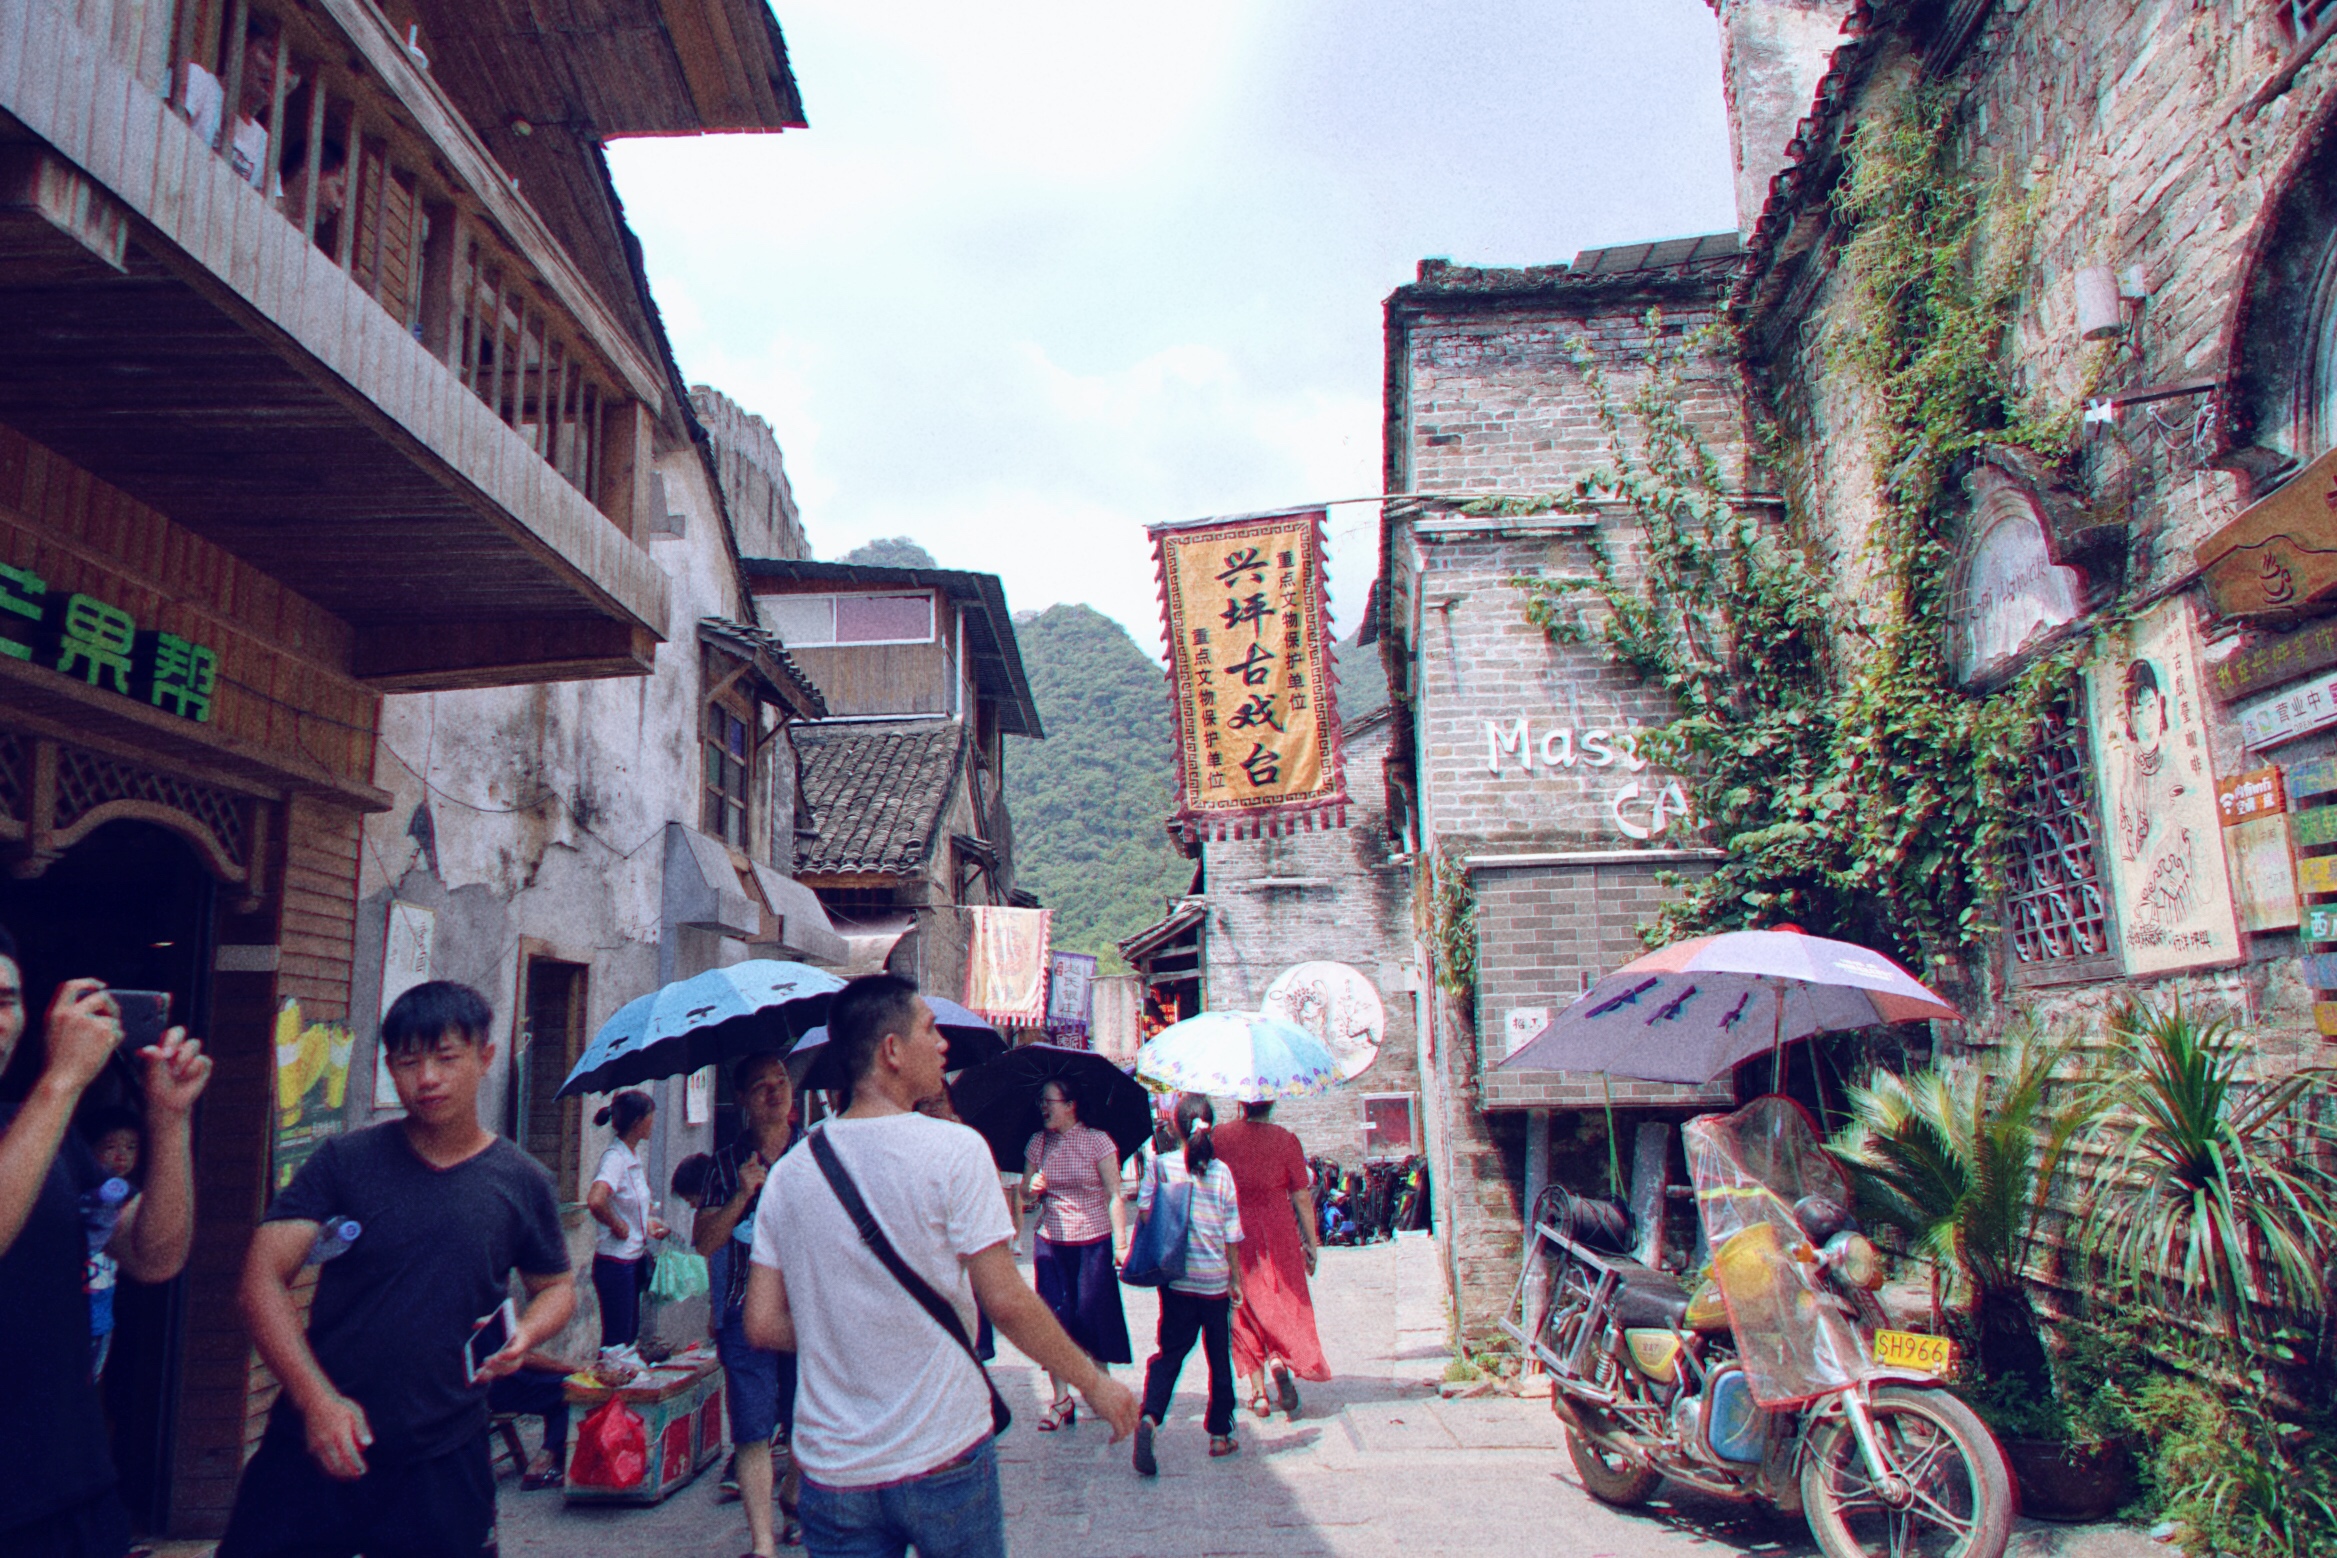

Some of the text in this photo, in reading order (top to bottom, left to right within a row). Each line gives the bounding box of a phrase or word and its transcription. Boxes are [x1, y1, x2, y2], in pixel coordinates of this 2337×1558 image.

[1213, 547, 1286, 788] 兴坪古戏台
[1276, 550, 1308, 712] 重点文物保护单位
[1191, 627, 1226, 790] 重点文物保护单位
[2275, 689, 2321, 724] 营业中
[2293, 719, 2314, 734] OPEN
[1877, 1333, 1944, 1364] SH966
